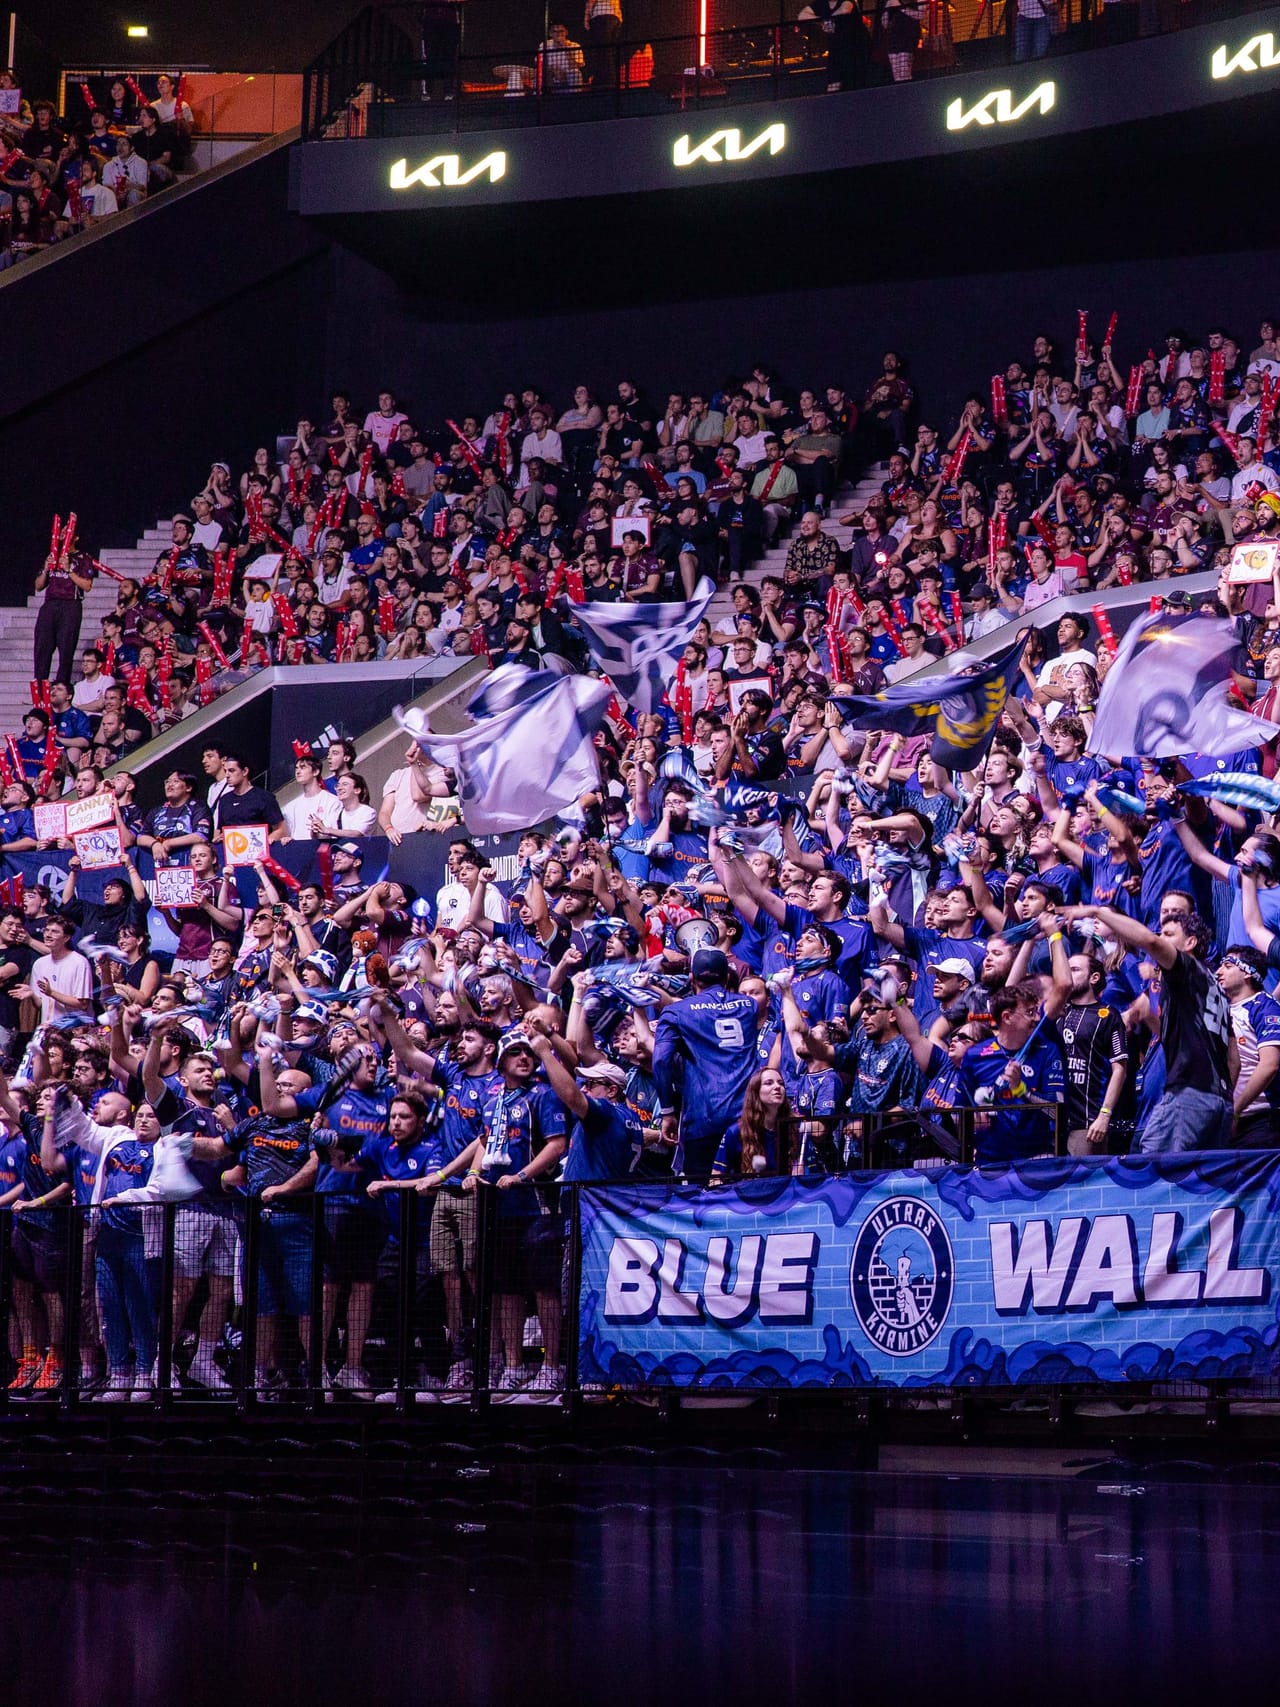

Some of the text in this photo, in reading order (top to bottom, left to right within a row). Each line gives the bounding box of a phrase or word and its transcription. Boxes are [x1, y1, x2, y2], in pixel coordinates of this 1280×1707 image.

[947, 82, 1055, 130] KIA
[674, 122, 785, 166] KIA
[390, 151, 507, 189] KIA
[690, 999, 752, 1011] MANCHETTE
[716, 1019, 745, 1048] 9
[252, 1136, 299, 1151] Orange
[871, 1203, 937, 1237] ULTRAS
[604, 1207, 1268, 1324] BLUE WALL
[865, 1311, 939, 1351] KARMINE
